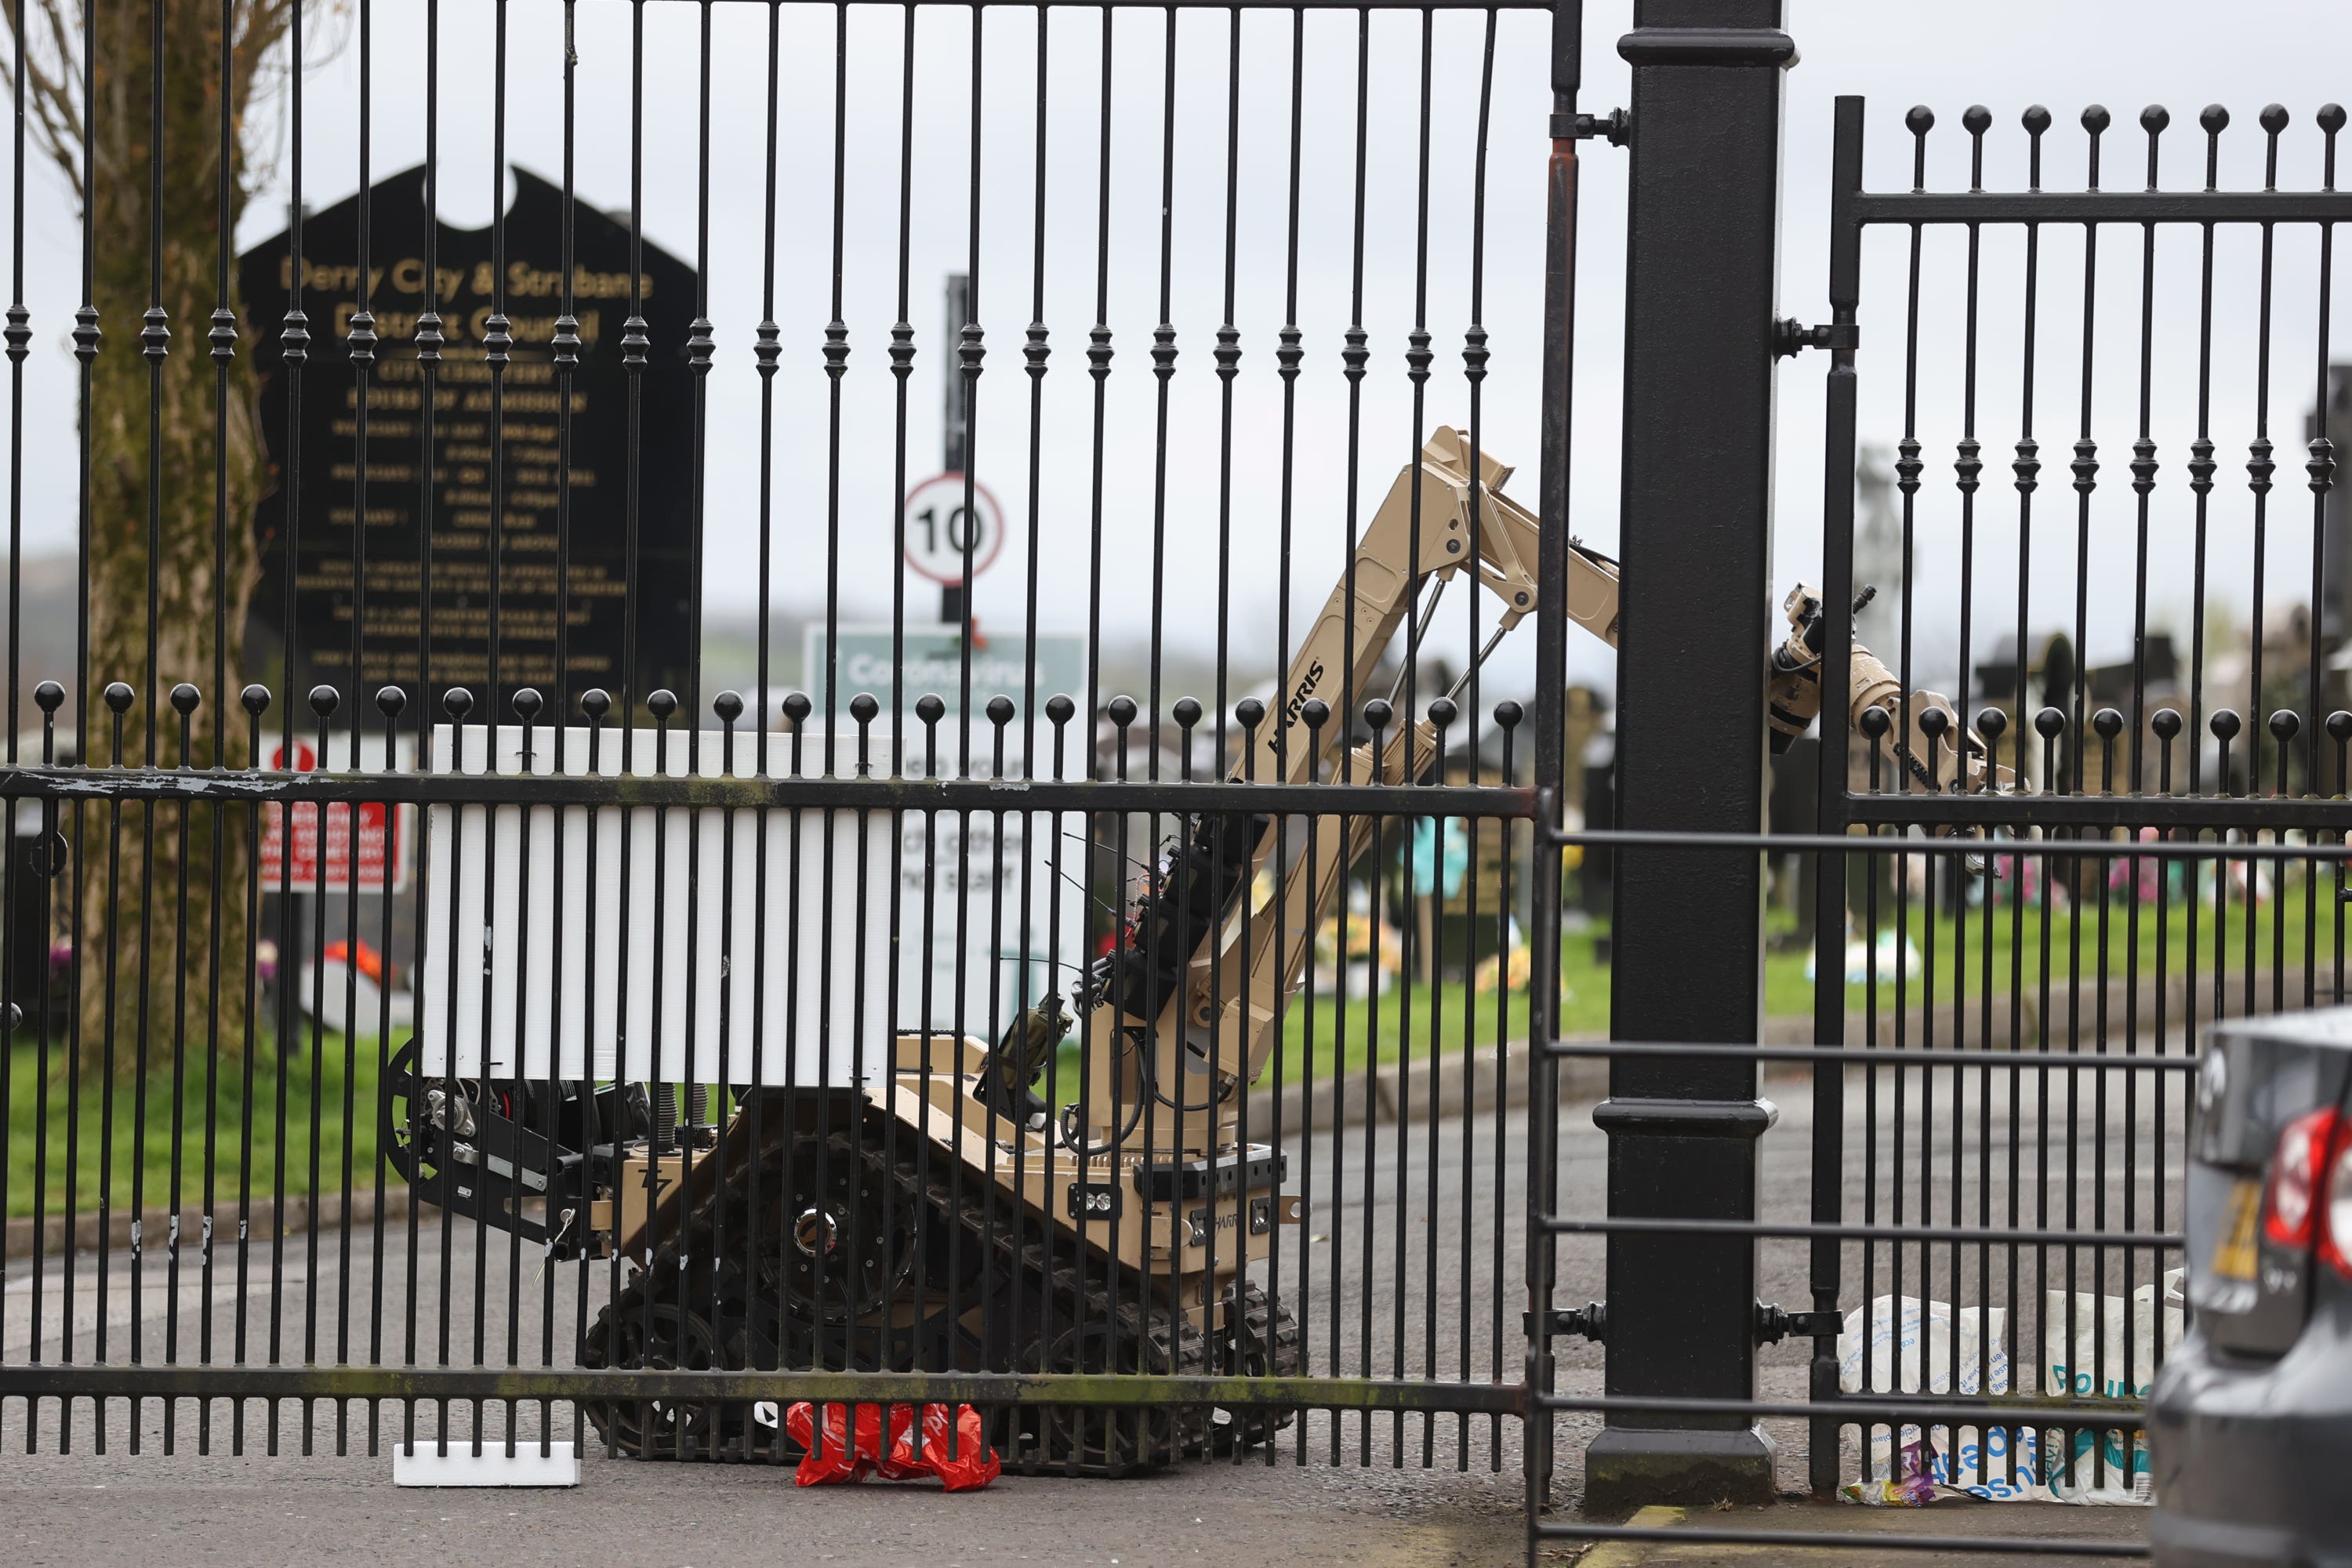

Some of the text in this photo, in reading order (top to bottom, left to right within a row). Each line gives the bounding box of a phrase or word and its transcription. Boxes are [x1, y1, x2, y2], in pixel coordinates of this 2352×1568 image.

[280, 256, 385, 297] Derry
[392, 259, 466, 303] Cty
[508, 261, 654, 299] Strbane
[335, 303, 600, 343] Dstrct Counil
[916, 506, 984, 554] 10
[1267, 659, 1324, 759] HRRIS
